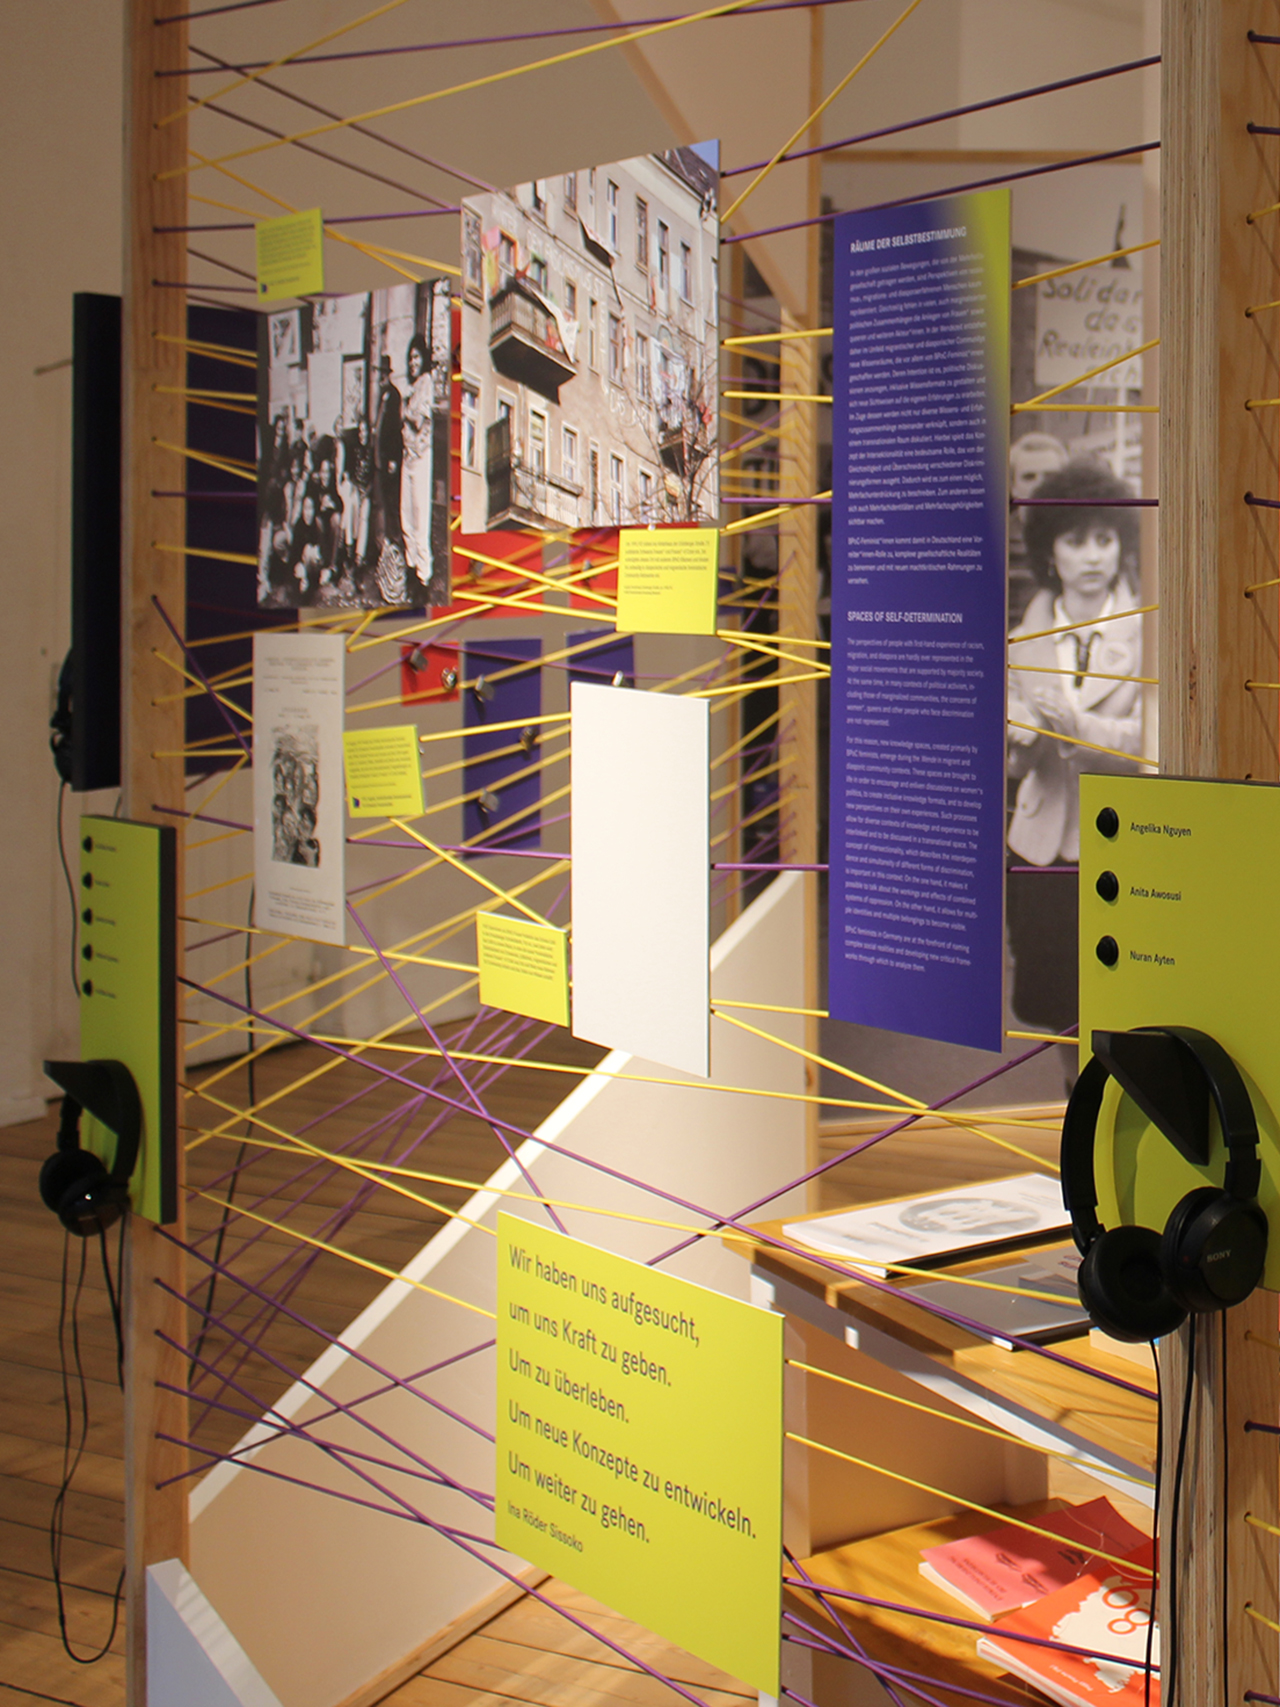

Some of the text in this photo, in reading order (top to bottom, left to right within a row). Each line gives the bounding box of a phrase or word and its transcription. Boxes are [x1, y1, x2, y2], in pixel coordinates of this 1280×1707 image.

[850, 226, 967, 253] RÄUME DER SELBSTBESTIMMUNG
[847, 611, 963, 624] SPACES OF SELF-DETERMINATION
[1130, 822, 1192, 838] Angelika Nguyen
[1130, 886, 1182, 901] Anita Awosusi
[1130, 951, 1175, 966] Nuran Ayten
[1206, 1249, 1232, 1263] SONY
[509, 1244, 700, 1348] Wir haben uns aufgesucht,
[509, 1302, 672, 1387] um uns Kraft zu geben.
[509, 1348, 629, 1424] Um zu überleben.
[509, 1399, 756, 1539] Um neue Konzepte zu entwickeln.
[508, 1450, 650, 1544] Um weiter zu gehen.
[508, 1501, 583, 1553] Ina Röder Sissoko
